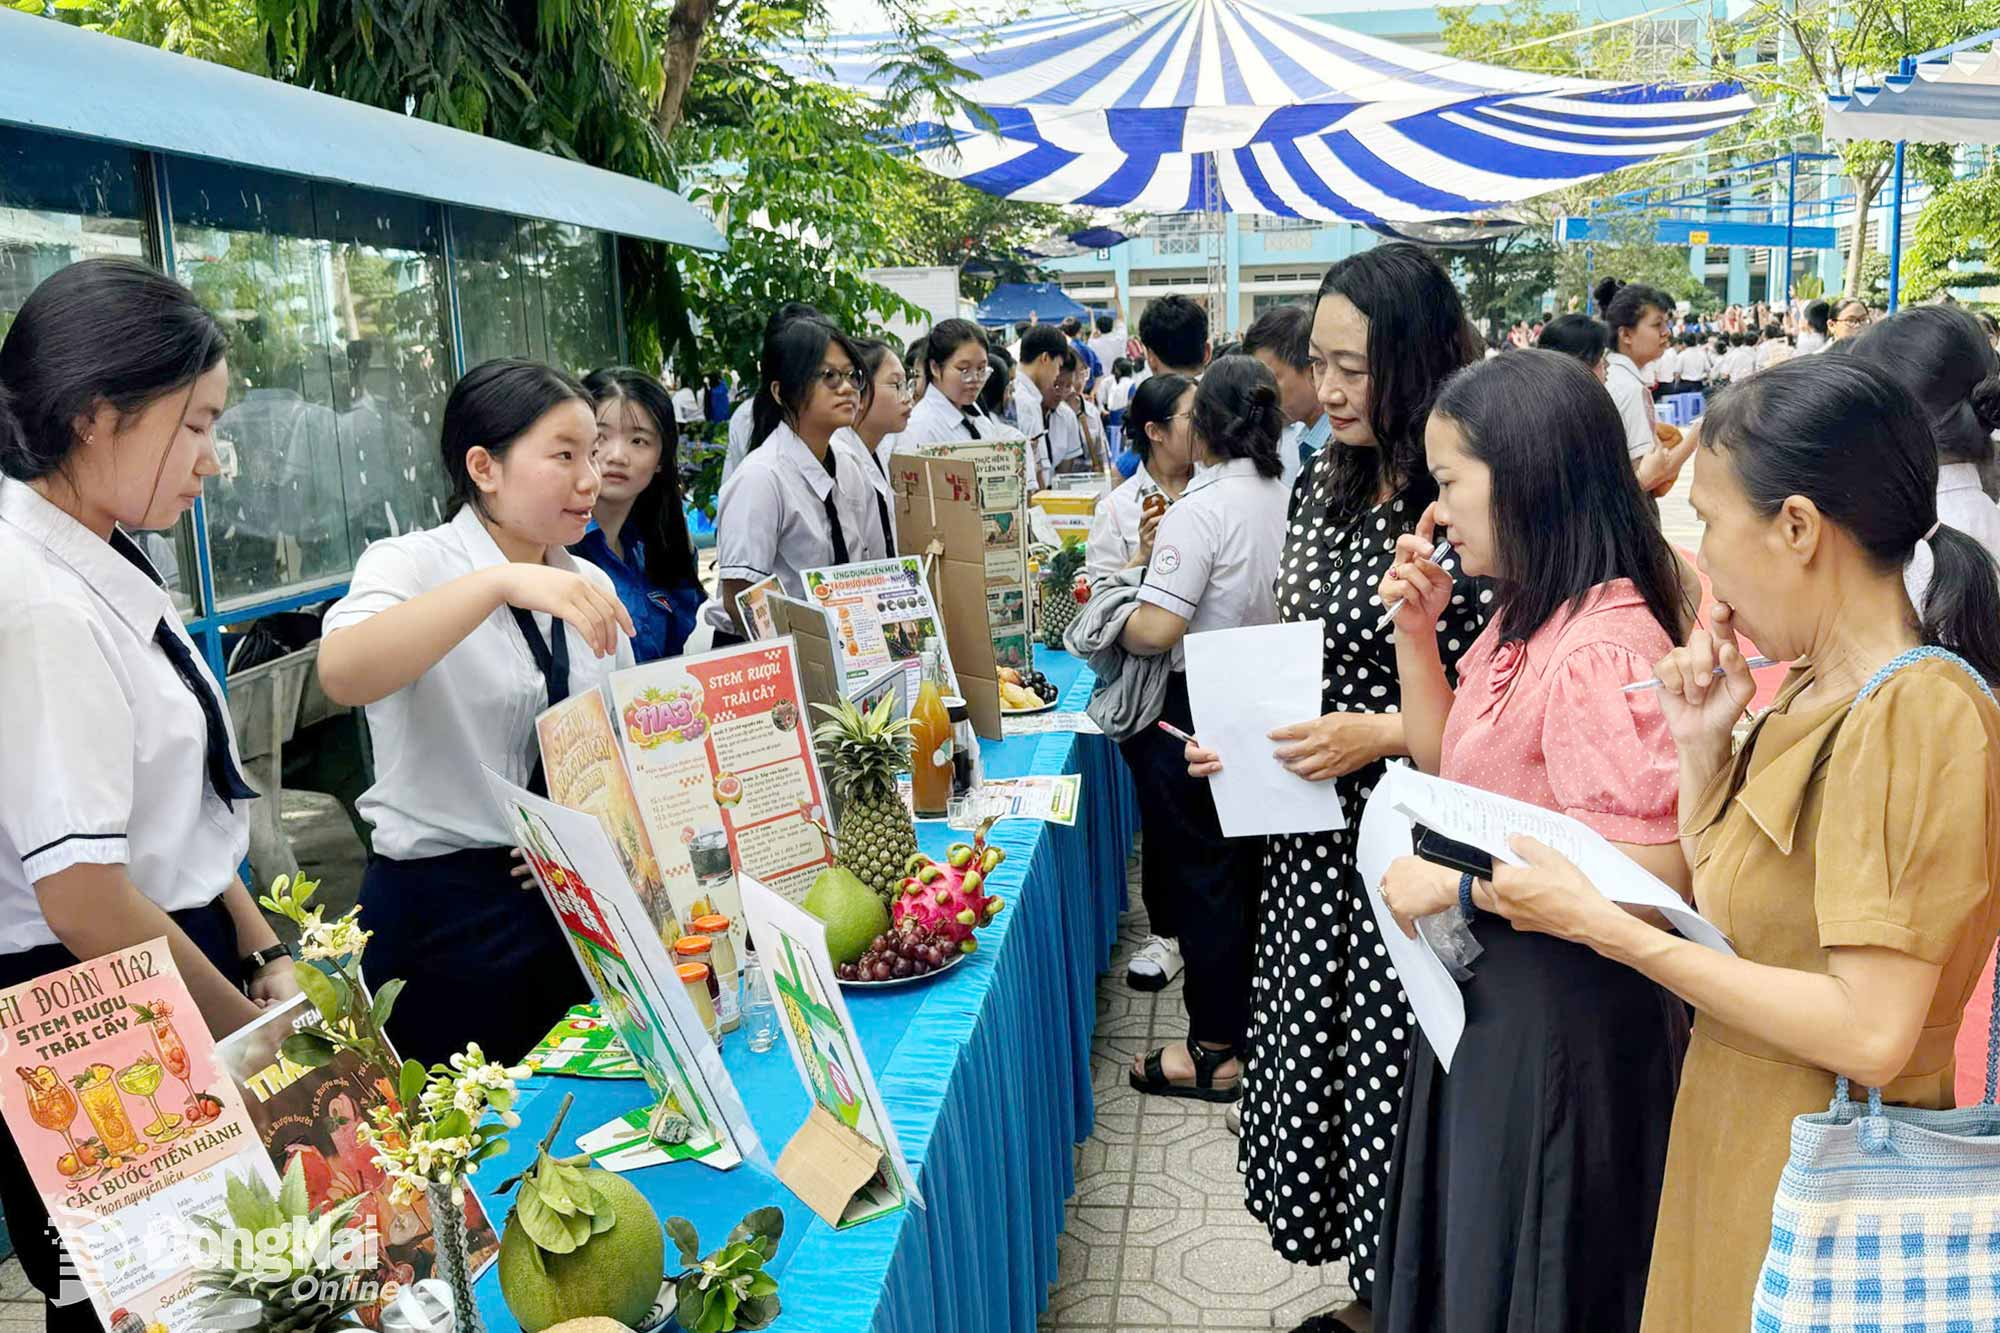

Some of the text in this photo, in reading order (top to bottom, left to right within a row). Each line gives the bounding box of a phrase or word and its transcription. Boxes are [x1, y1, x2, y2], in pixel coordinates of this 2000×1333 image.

[709, 662, 782, 690] STEM RƯỢU
[722, 683, 777, 708] TRÁI CÂY
[636, 699, 692, 735] 11A3
[31, 966, 105, 1017] ĐOÀN
[109, 951, 160, 990] 11A2
[16, 994, 129, 1047] STEM RƯỢU
[66, 1121, 243, 1209] CÁC BƯỚC TIẾN HÀNH
